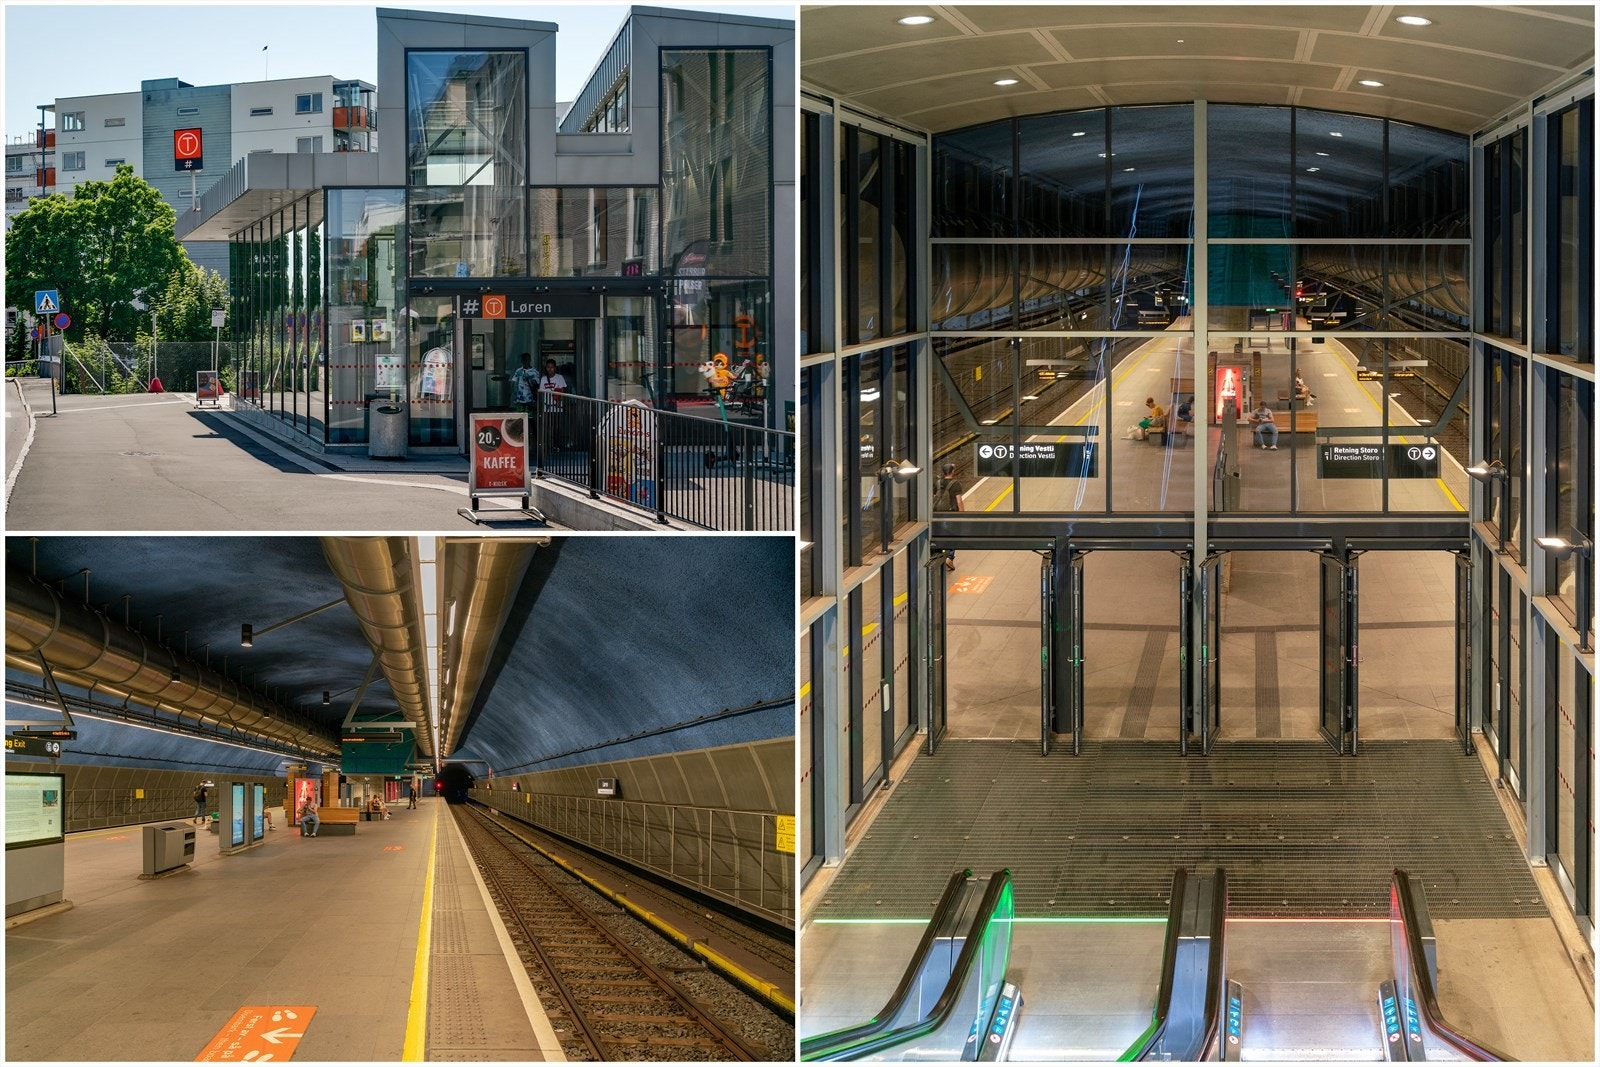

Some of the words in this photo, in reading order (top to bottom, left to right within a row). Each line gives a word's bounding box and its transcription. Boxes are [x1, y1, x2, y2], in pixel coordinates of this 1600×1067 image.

[511, 300, 552, 313] Løren
[478, 431, 500, 446] 20,-
[1009, 445, 1034, 453] Rning
[483, 456, 517, 469] KAFFE
[14, 739, 26, 748] Exit
